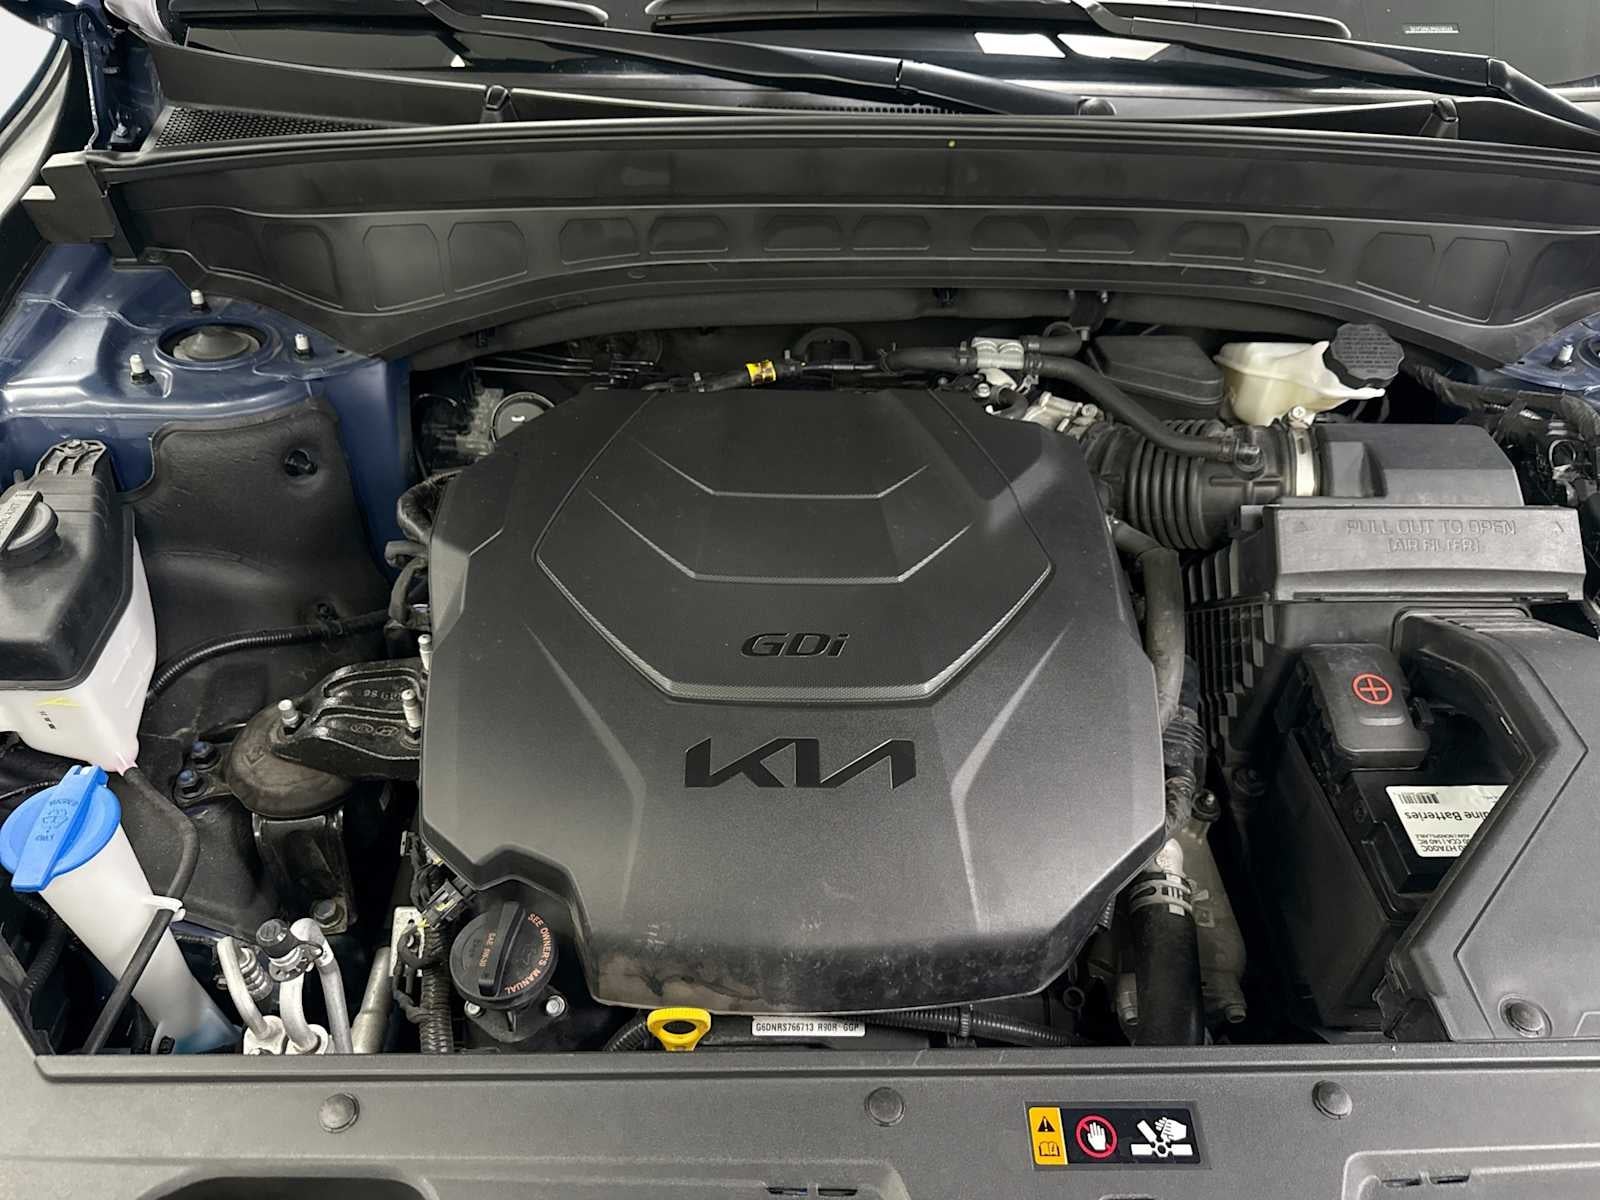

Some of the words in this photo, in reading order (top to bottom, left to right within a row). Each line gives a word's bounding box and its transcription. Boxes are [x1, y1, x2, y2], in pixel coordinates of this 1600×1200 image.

[1346, 519, 1394, 535] PULL
[1396, 519, 1434, 536] OUT
[1439, 519, 1463, 535] TO
[1467, 519, 1517, 536] OPEN
[741, 632, 849, 658] GDi
[684, 736, 917, 790] KIA
[1404, 811, 1463, 821] Batteries
[528, 913, 545, 927] SEE
[538, 927, 552, 967] OWNER'S
[504, 968, 541, 995] MANUAL
